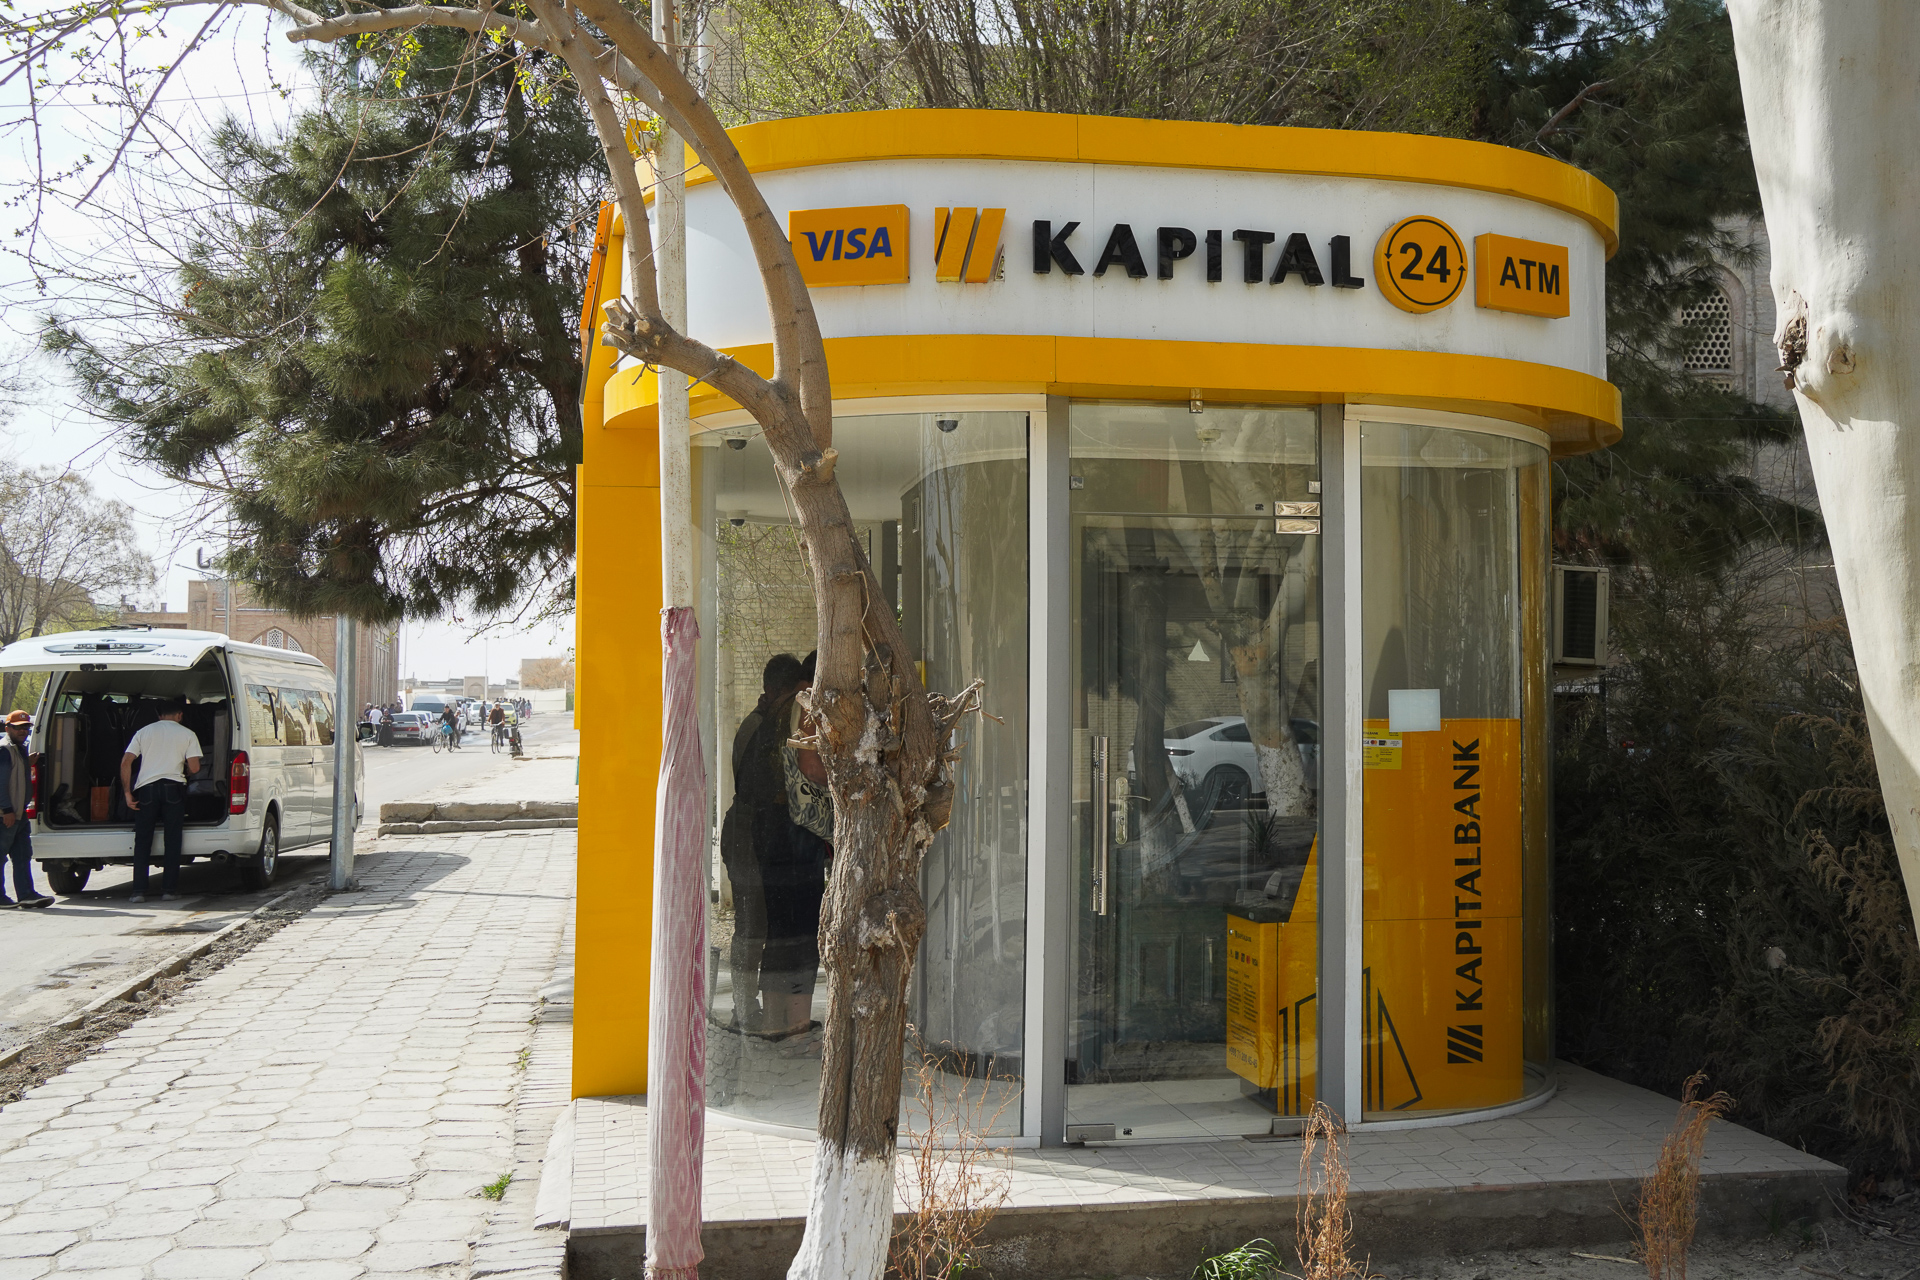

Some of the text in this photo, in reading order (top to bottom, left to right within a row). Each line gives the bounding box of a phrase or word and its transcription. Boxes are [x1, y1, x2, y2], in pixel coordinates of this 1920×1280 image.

[800, 227, 892, 261] VISA
[1033, 220, 1364, 289] KAPITAL
[1400, 242, 1451, 283] 24
[1500, 256, 1560, 295] ATM
[1453, 738, 1482, 1011] KAPITALBANK
